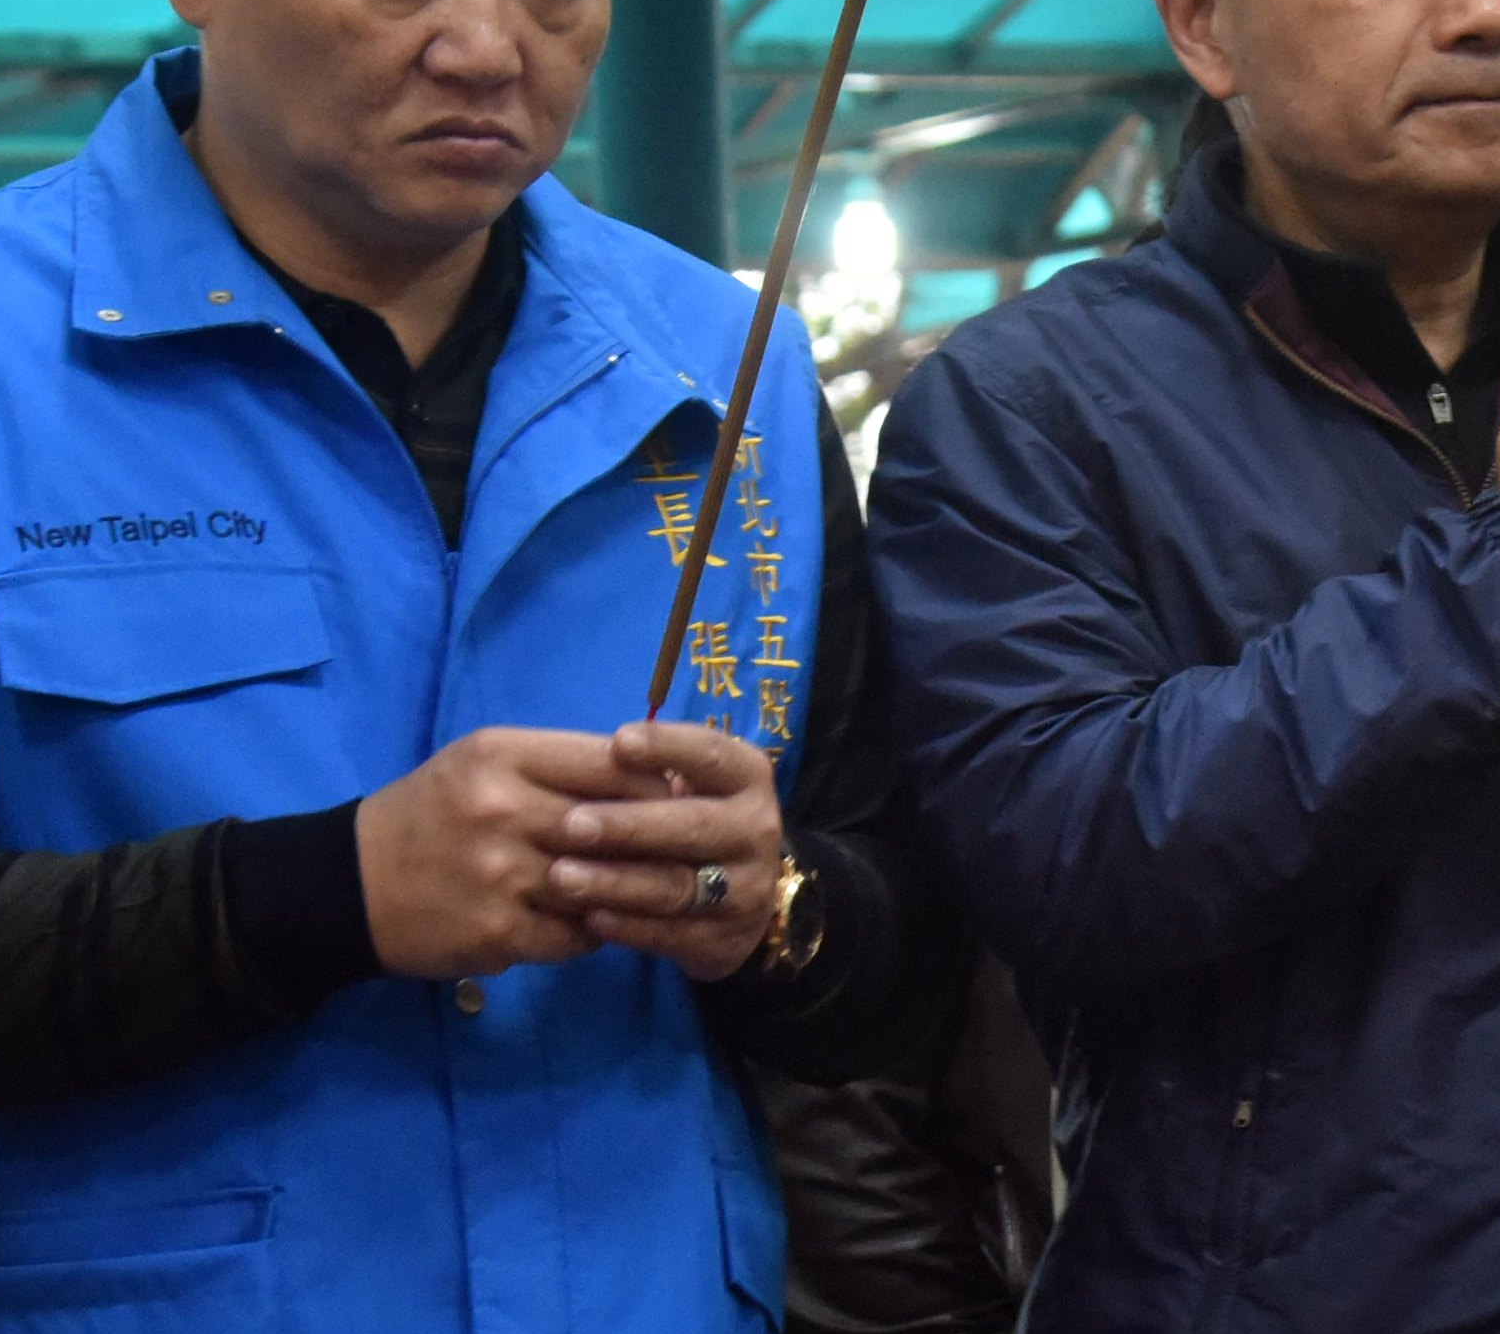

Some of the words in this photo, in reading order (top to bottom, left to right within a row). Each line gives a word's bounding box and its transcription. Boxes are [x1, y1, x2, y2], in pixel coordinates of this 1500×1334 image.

[15, 522, 92, 552] New
[99, 512, 197, 546] Taipei
[207, 510, 267, 545] City
